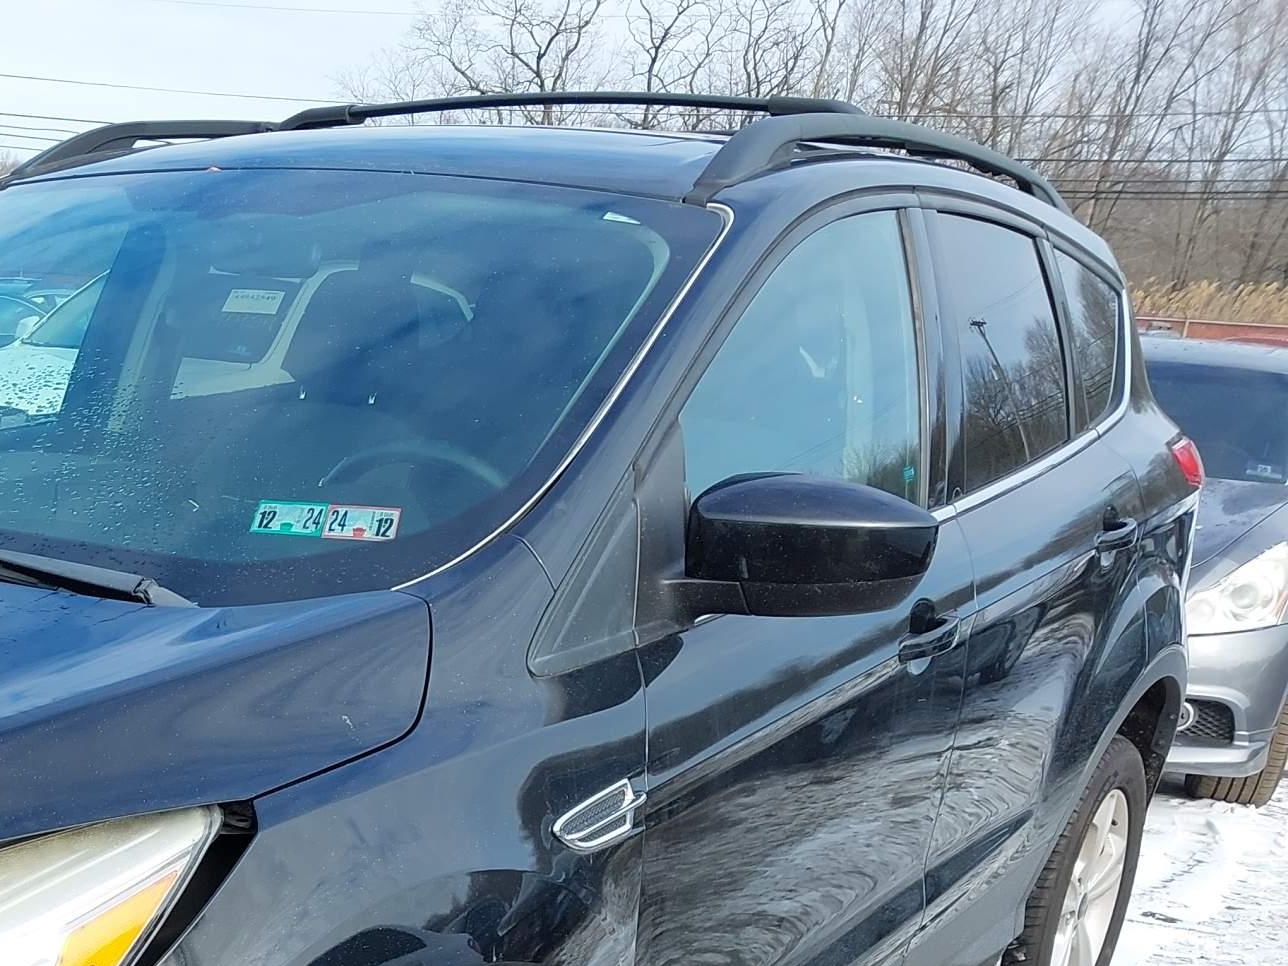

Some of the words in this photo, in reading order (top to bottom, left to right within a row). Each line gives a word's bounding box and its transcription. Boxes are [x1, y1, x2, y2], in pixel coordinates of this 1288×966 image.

[257, 510, 277, 529] 12
[303, 507, 324, 530] 24
[328, 509, 349, 532] 24
[376, 517, 394, 537] 12
